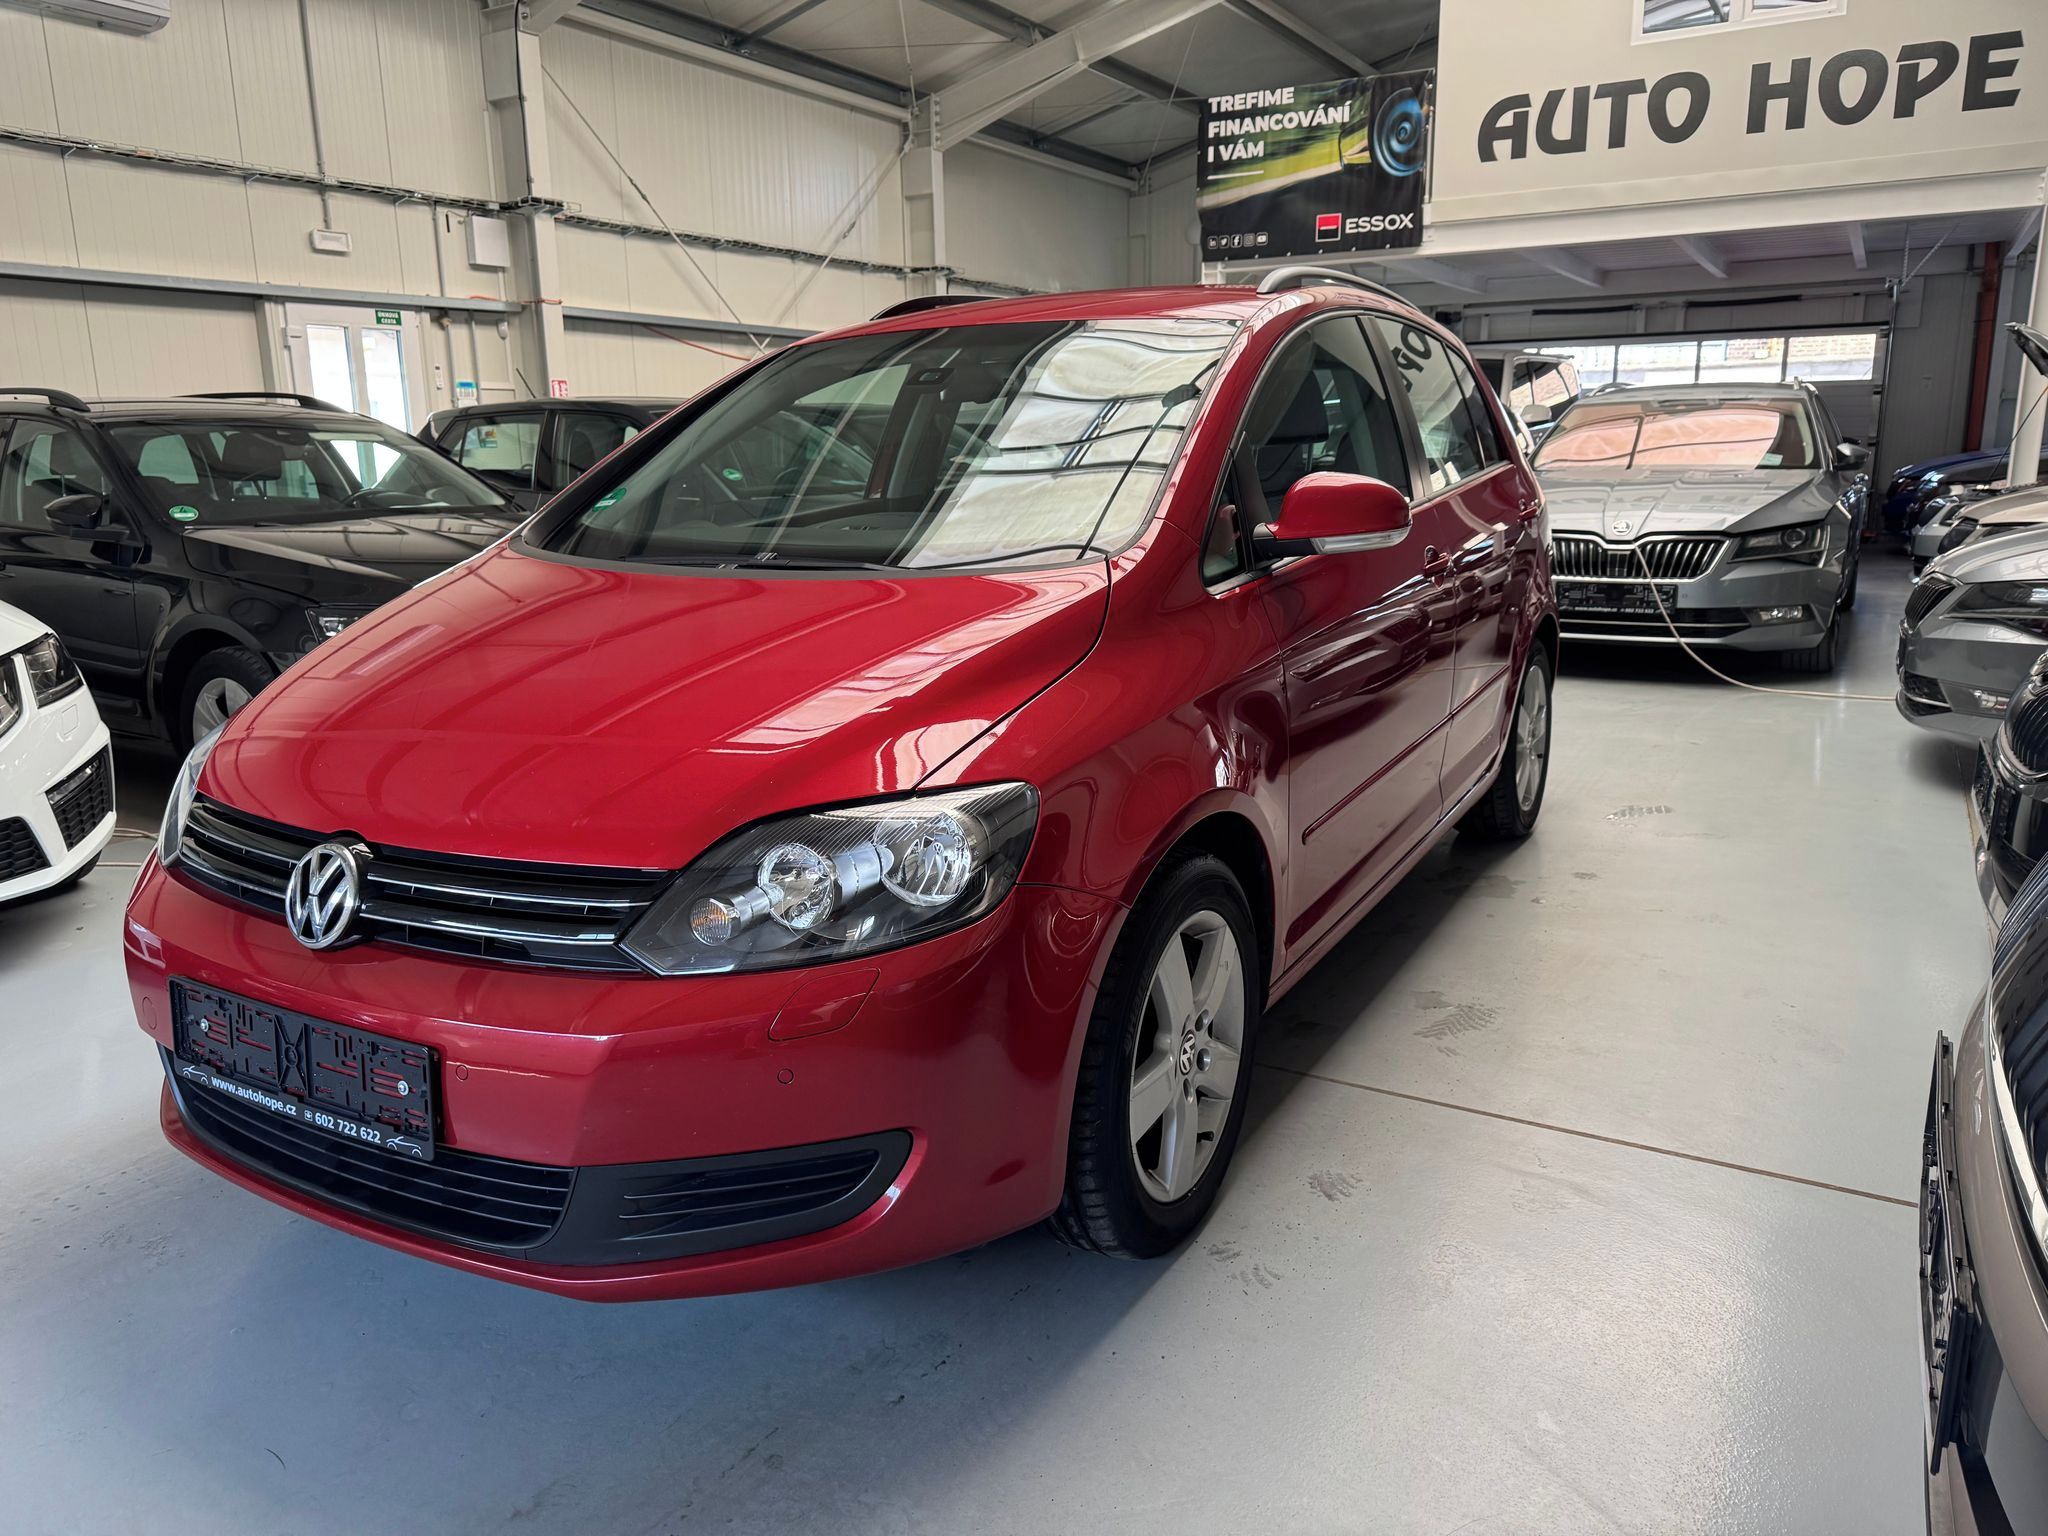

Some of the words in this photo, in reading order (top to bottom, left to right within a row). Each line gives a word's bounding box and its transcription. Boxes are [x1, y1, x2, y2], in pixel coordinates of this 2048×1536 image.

[1208, 87, 1295, 113] TREFIME
[1478, 71, 1711, 163] AUTO
[1746, 30, 2025, 134] HOPE
[1207, 101, 1352, 138] FINANCOVÁNÍ
[1207, 146, 1215, 163] I
[1218, 139, 1265, 161] VÁM
[1345, 213, 1415, 234] ESSOX
[211, 1076, 297, 1116] www.autohope.cz
[315, 1112, 335, 1130] 602
[337, 1119, 357, 1137] 722
[360, 1126, 381, 1144] 622
